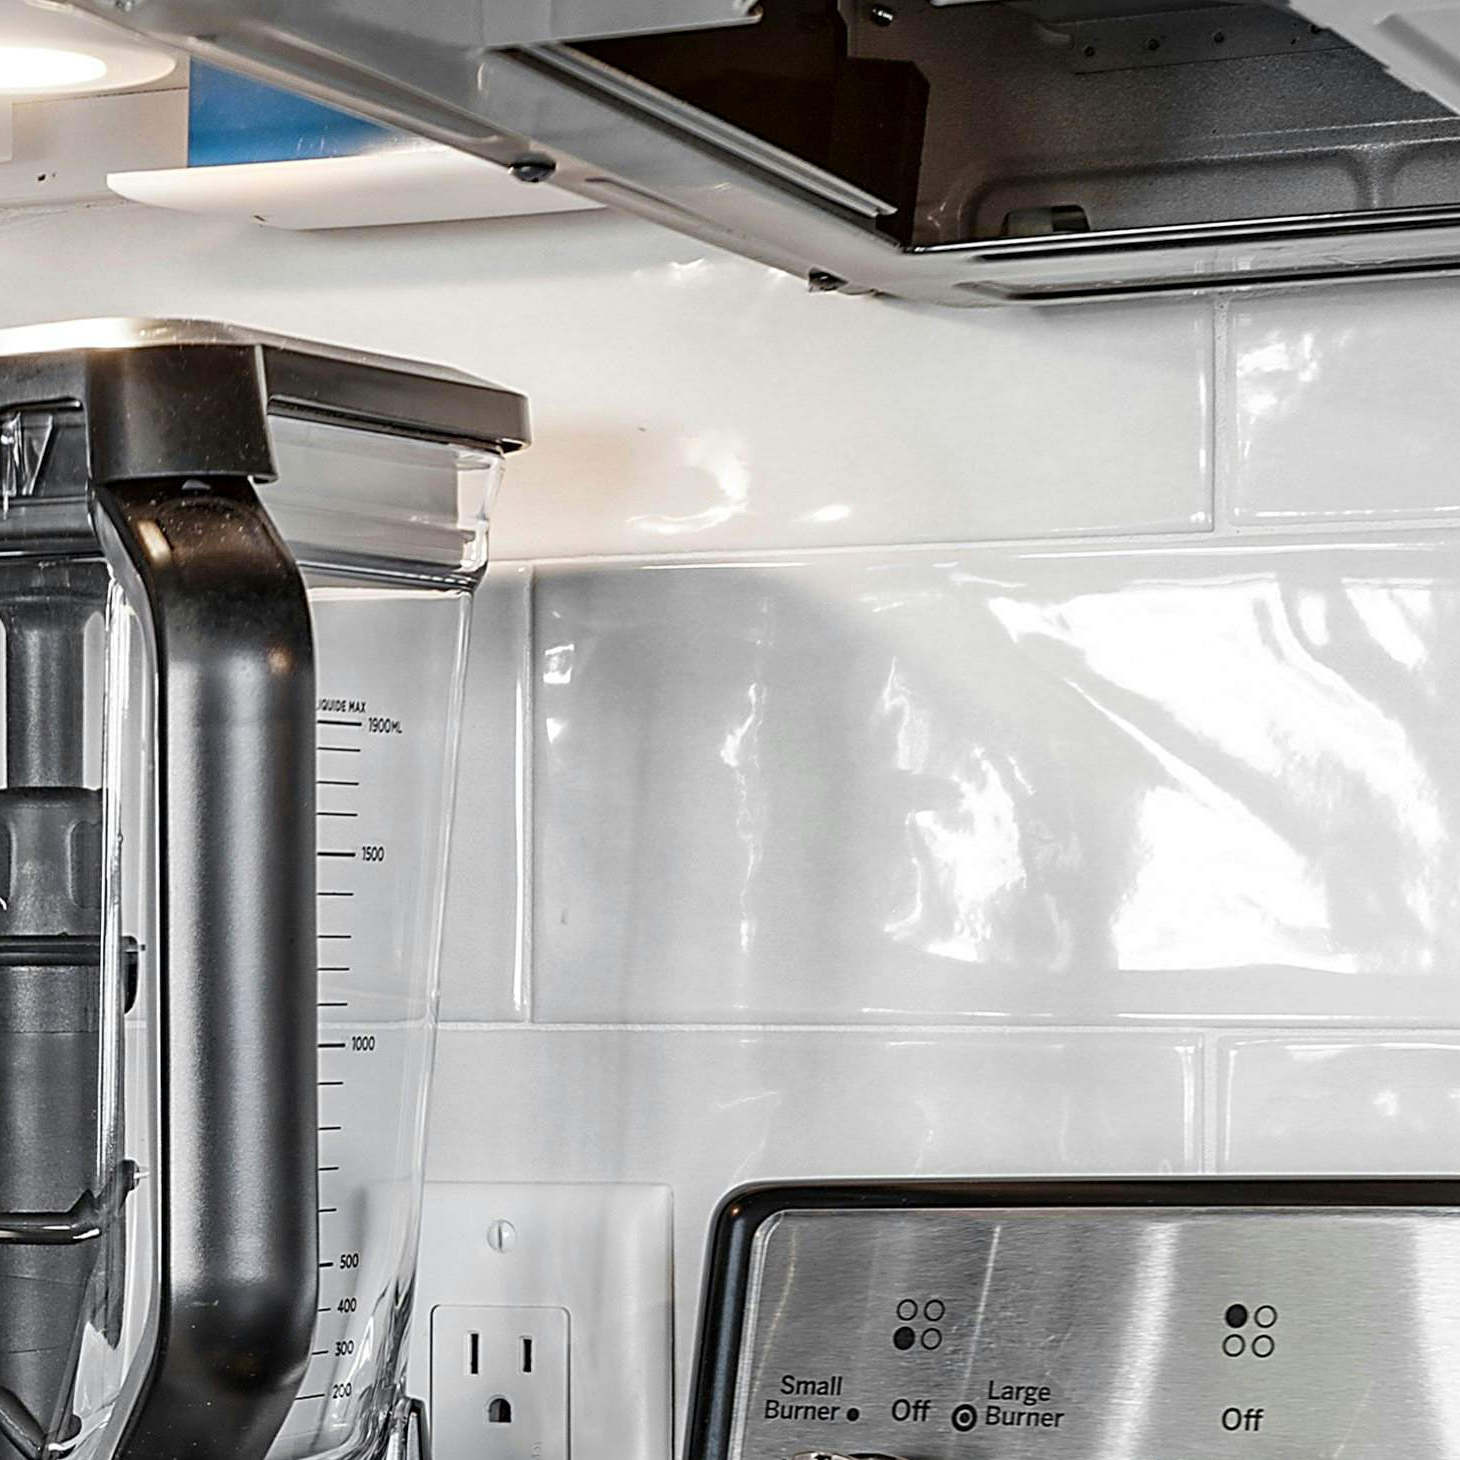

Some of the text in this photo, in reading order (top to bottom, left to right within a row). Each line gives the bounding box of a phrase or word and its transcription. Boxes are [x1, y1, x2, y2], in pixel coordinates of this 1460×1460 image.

[361, 846, 385, 861] 1500
[352, 1036, 375, 1051] 1000
[339, 1253, 359, 1269] 500
[337, 1298, 357, 1314] 400
[335, 1341, 354, 1356] 300
[332, 1383, 352, 1399] 200
[780, 1375, 843, 1396] Small
[988, 1380, 1051, 1406] Large
[764, 1400, 841, 1422] Burner
[891, 1398, 932, 1422] Off
[985, 1406, 1065, 1428] Burner
[1221, 1407, 1265, 1432] Off
